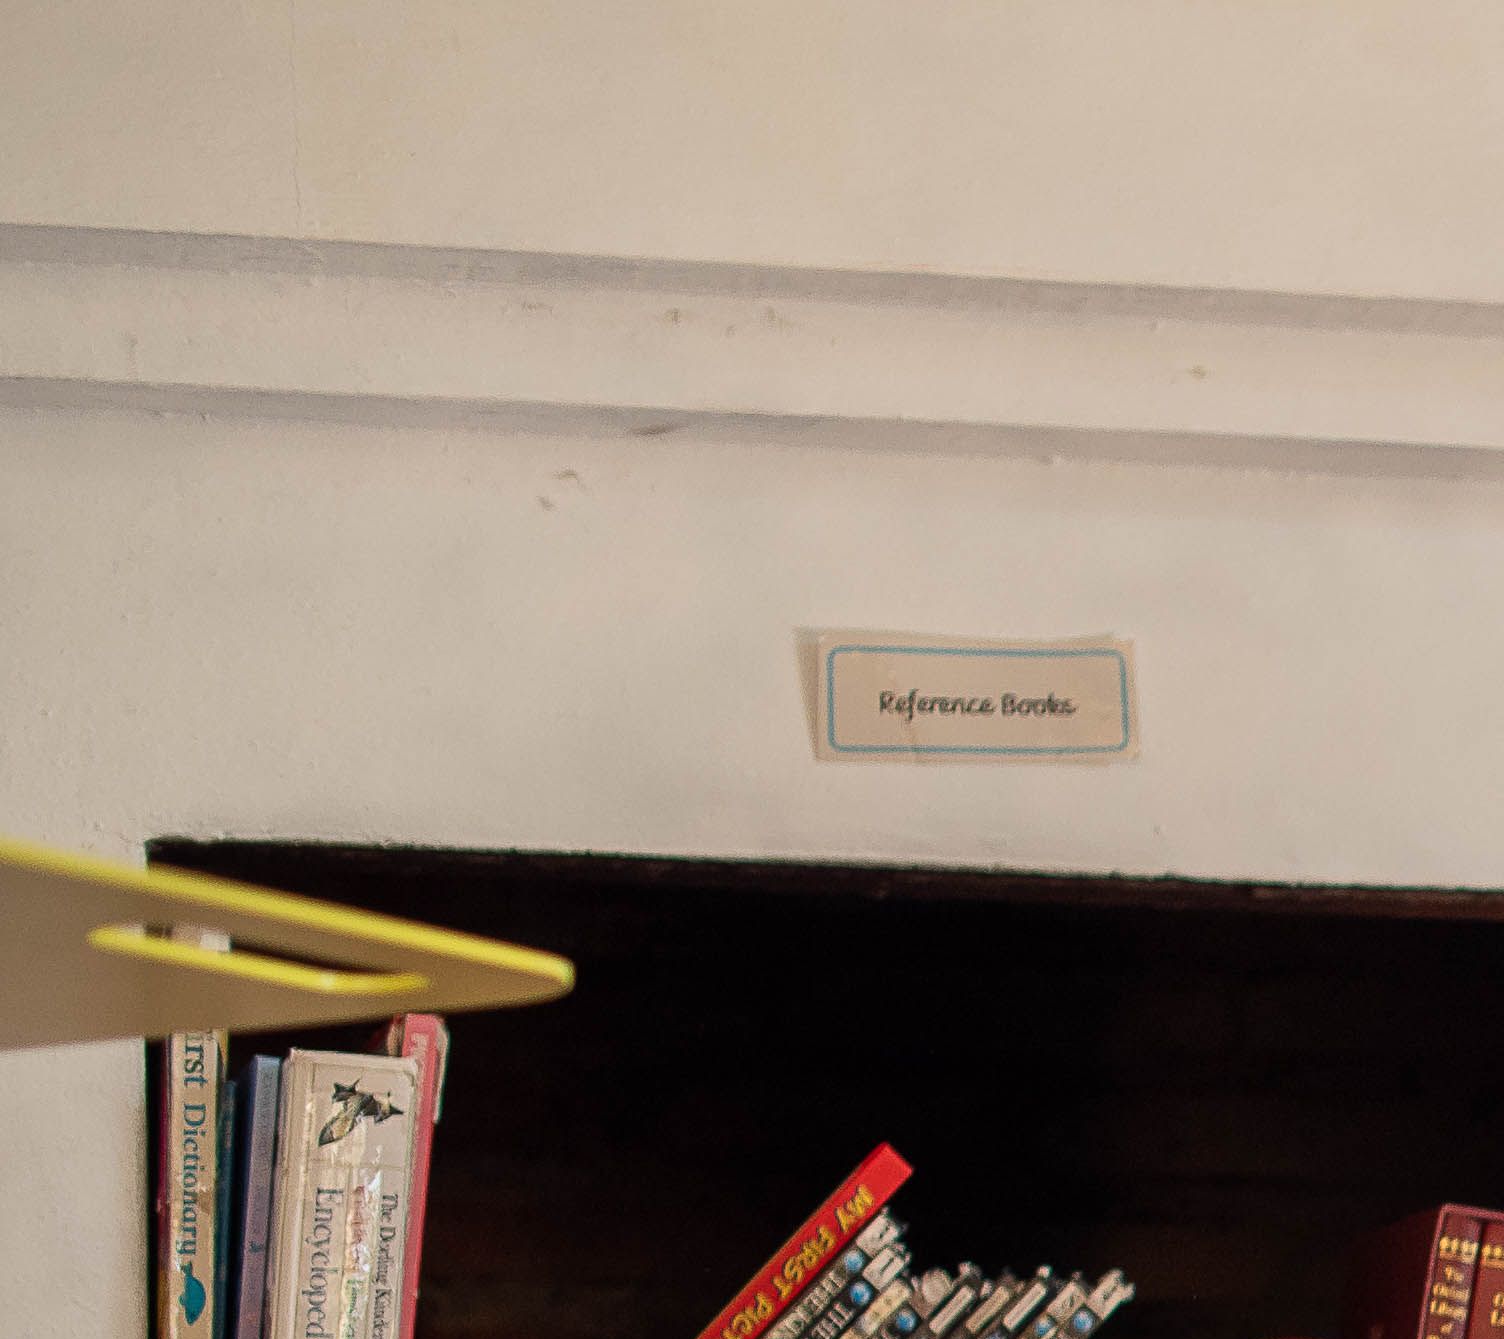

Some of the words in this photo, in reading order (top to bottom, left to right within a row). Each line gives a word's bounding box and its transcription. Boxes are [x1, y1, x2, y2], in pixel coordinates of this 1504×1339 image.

[879, 689, 993, 723] Reference
[1001, 692, 1078, 716] Books
[167, 1101, 211, 1256] Dictionary
[835, 1183, 875, 1230] MY
[771, 1230, 839, 1299] FIRST
